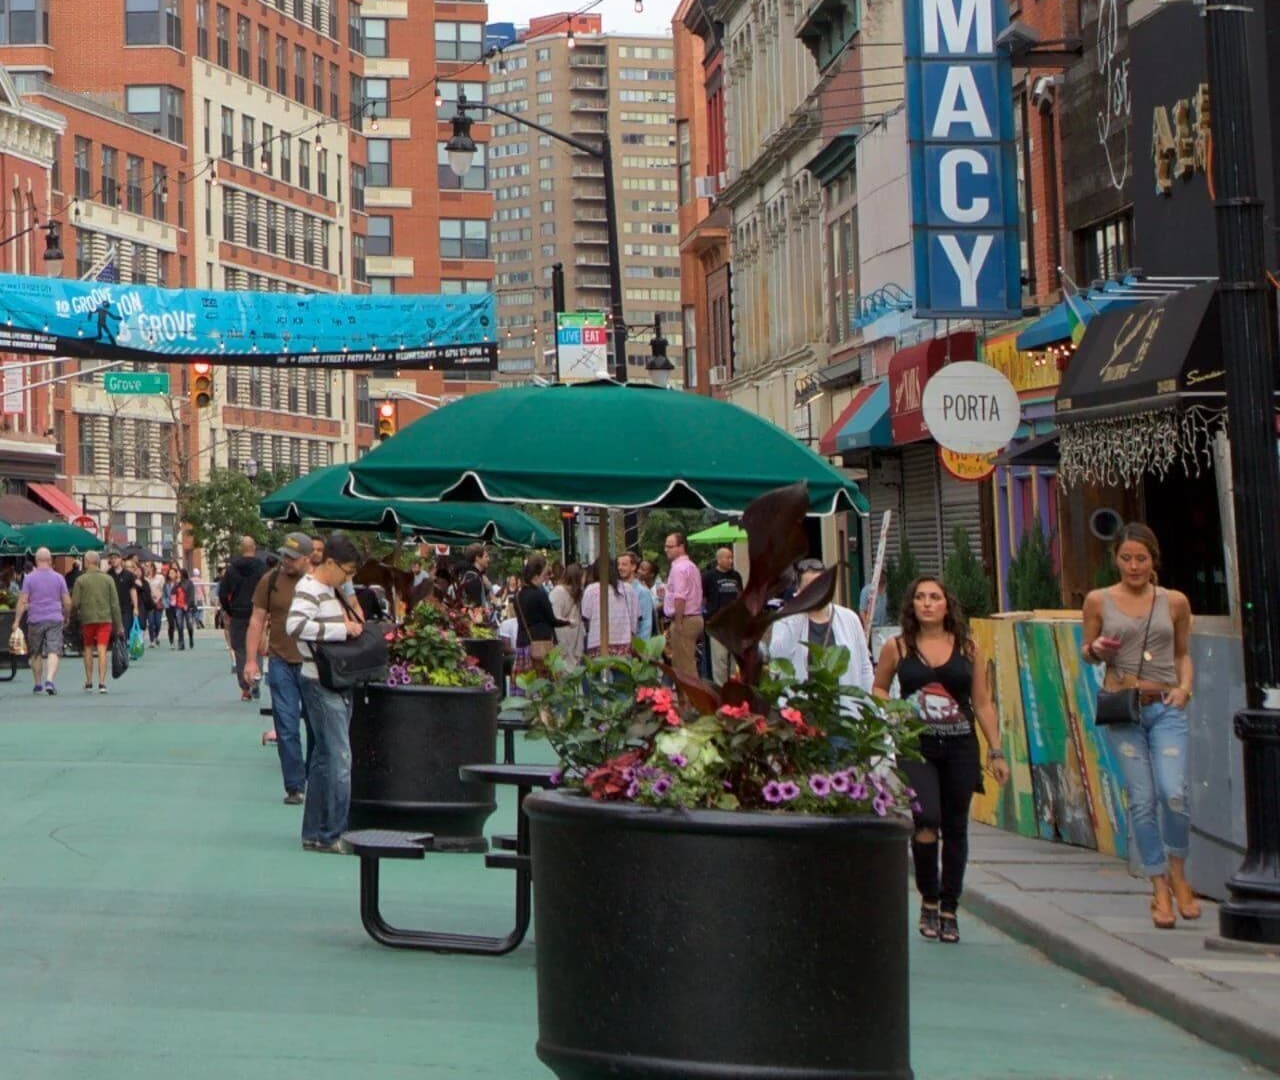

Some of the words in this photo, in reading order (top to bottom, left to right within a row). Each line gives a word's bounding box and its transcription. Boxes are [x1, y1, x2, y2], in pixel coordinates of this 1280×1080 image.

[72, 287, 115, 313] GROOVE
[138, 310, 198, 342] GROVE
[562, 331, 580, 342] LIVE
[584, 331, 600, 342] EAT
[109, 379, 142, 392] Grove
[943, 394, 1001, 421] PORTA
